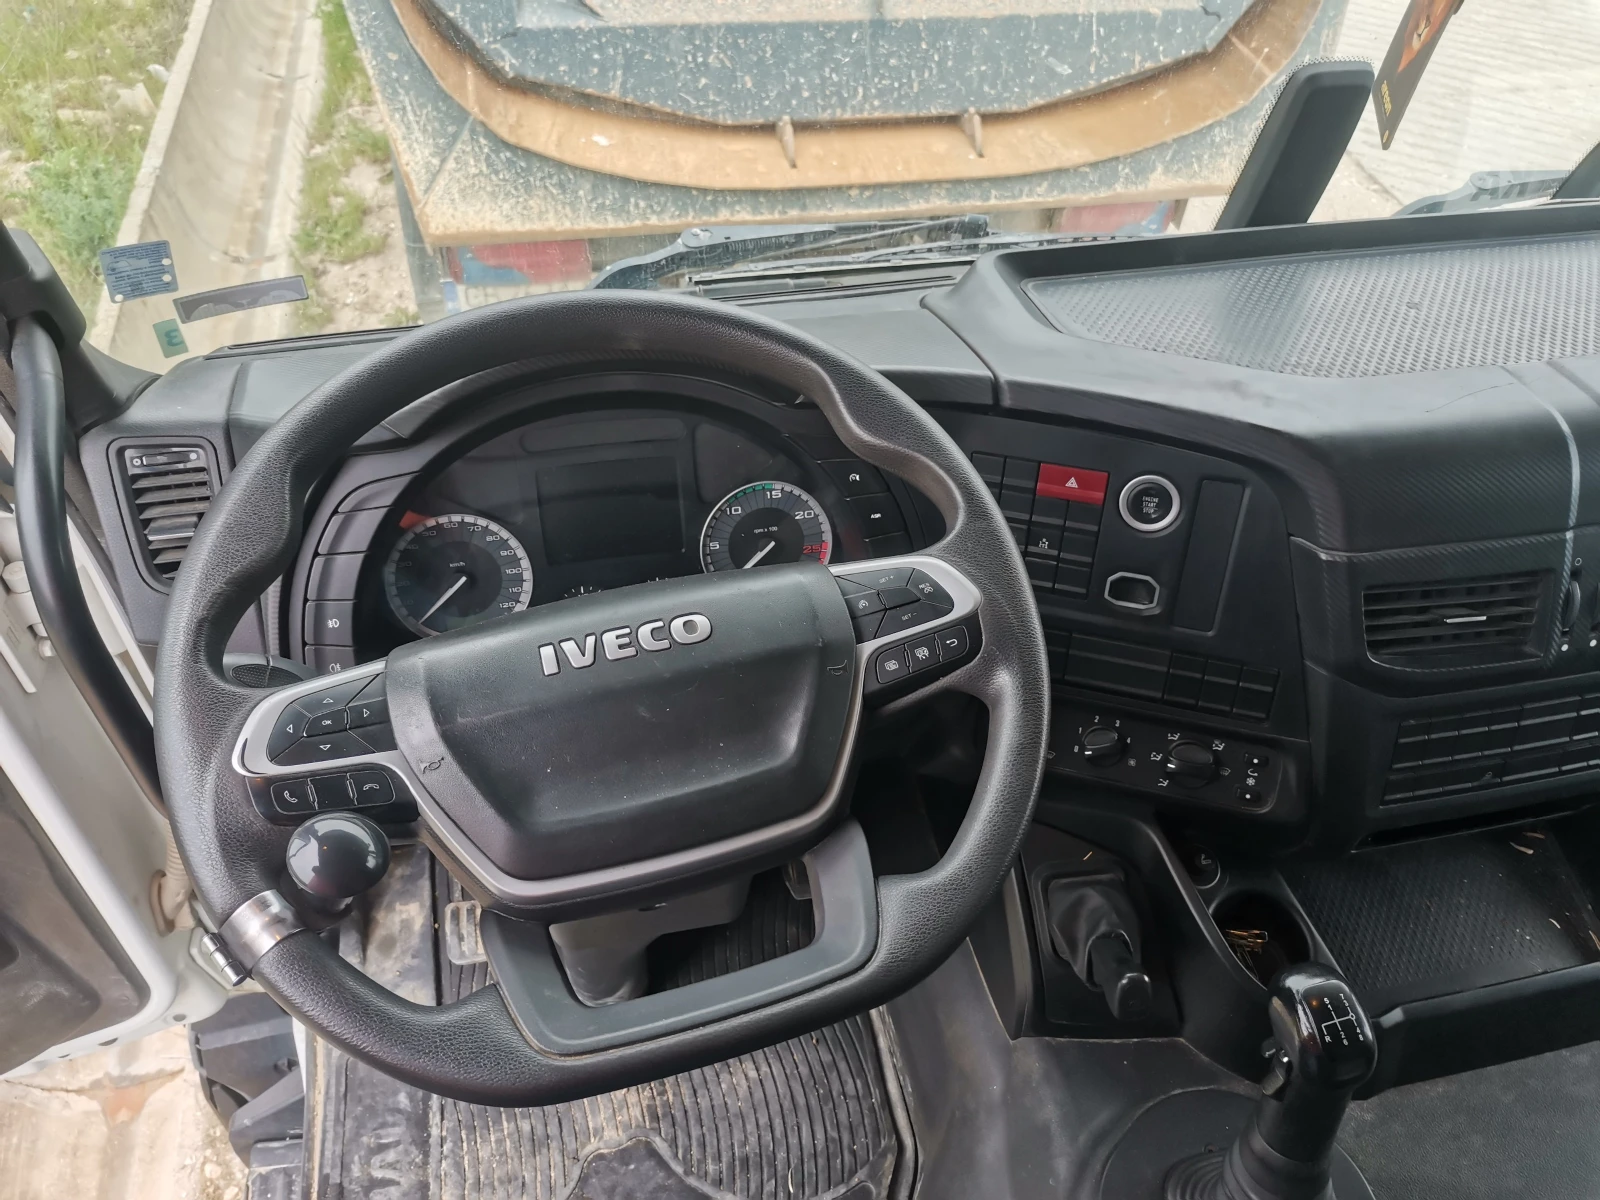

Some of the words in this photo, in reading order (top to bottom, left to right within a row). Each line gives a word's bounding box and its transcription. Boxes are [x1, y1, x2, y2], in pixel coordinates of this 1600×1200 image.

[766, 490, 782, 499] 15
[726, 506, 742, 515] 10
[795, 510, 815, 520] 20
[709, 541, 720, 550] 5
[802, 545, 822, 554] 25
[537, 611, 713, 677] IVECO
[1094, 715, 1099, 723] 2
[1074, 745, 1079, 753] 0
